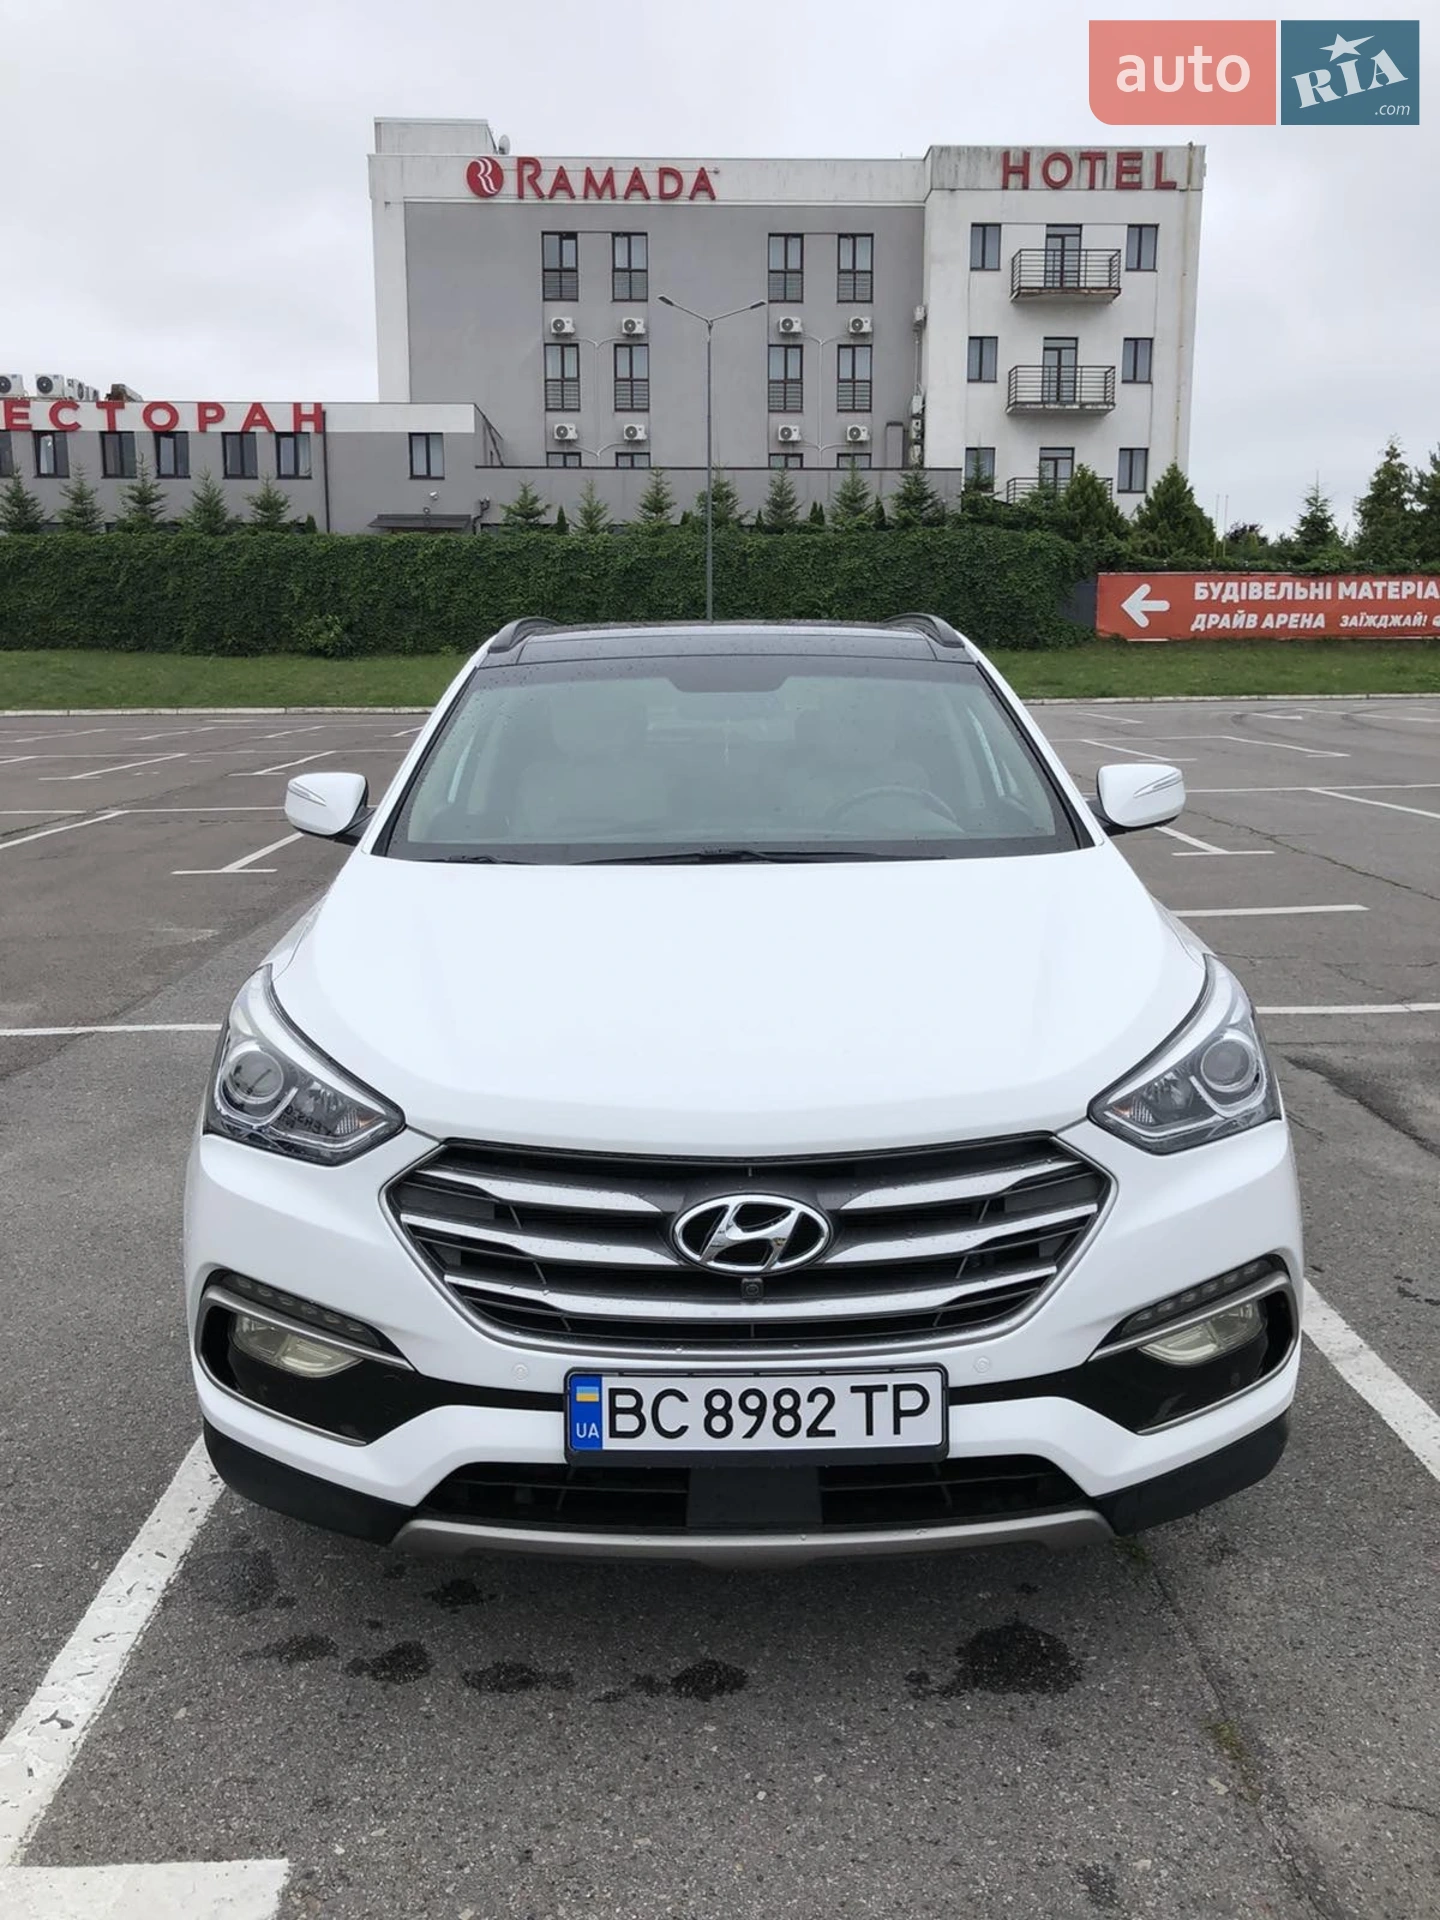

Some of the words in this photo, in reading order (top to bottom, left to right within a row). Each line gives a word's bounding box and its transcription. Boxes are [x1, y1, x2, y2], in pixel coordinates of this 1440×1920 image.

[516, 157, 716, 200] RAMADA
[1002, 152, 1177, 190] HOTEL
[4, 398, 323, 433] ЕСТОРАН
[1194, 581, 1332, 603] БУДІВЕЛЬНІ
[1338, 581, 1440, 600] МАТЕРІА
[1190, 610, 1257, 631] ДРАЙВ
[1260, 613, 1325, 630] АРЕНА
[1339, 611, 1428, 629] ЗАЇЖДЖАЙ!
[607, 1387, 690, 1439] BC
[703, 1386, 837, 1439] 8982
[849, 1382, 931, 1436] TP
[576, 1422, 600, 1439] UA
